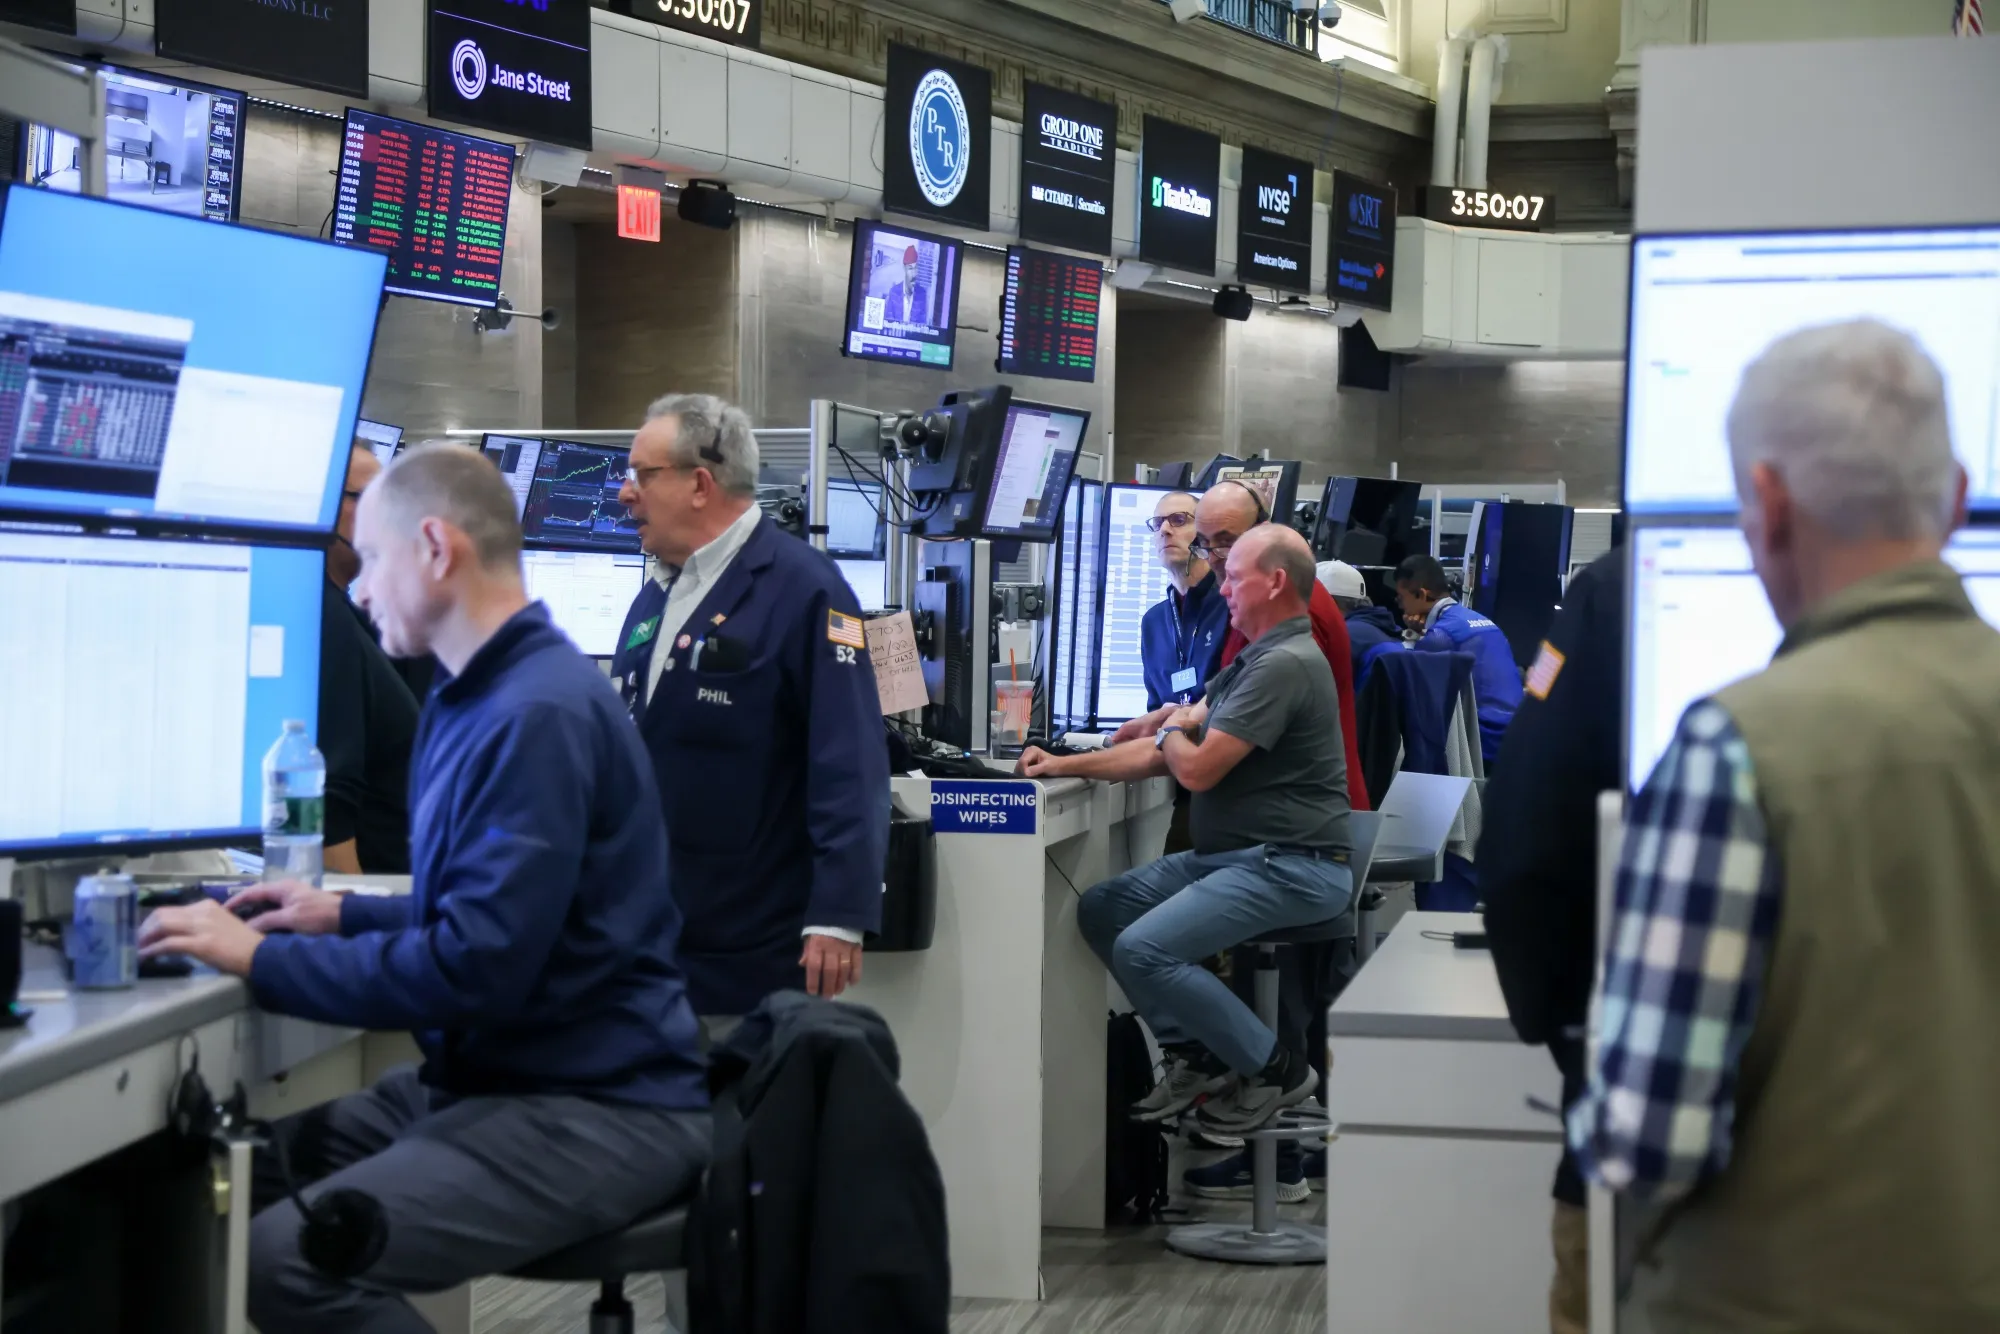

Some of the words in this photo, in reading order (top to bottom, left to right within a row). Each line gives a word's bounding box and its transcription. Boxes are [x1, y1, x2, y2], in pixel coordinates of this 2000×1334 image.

[491, 64, 525, 91] Jane
[527, 72, 571, 101] Street
[927, 107, 955, 168] PTR
[1041, 113, 1079, 140] GROUP
[1080, 124, 1103, 147] ONE
[1050, 138, 1095, 156] TRADING
[1044, 189, 1074, 208] CITADEL
[1162, 182, 1211, 218] TradeZero
[1451, 190, 1544, 221] 3:50:07
[625, 190, 657, 236] EXIT
[1358, 194, 1382, 229] SRT
[1253, 252, 1278, 267] American
[1278, 256, 1298, 271] Options
[836, 645, 857, 665] 52
[697, 687, 733, 705] PHIL
[930, 792, 1037, 807] DISINFECTING
[958, 811, 1008, 824] WIPES
